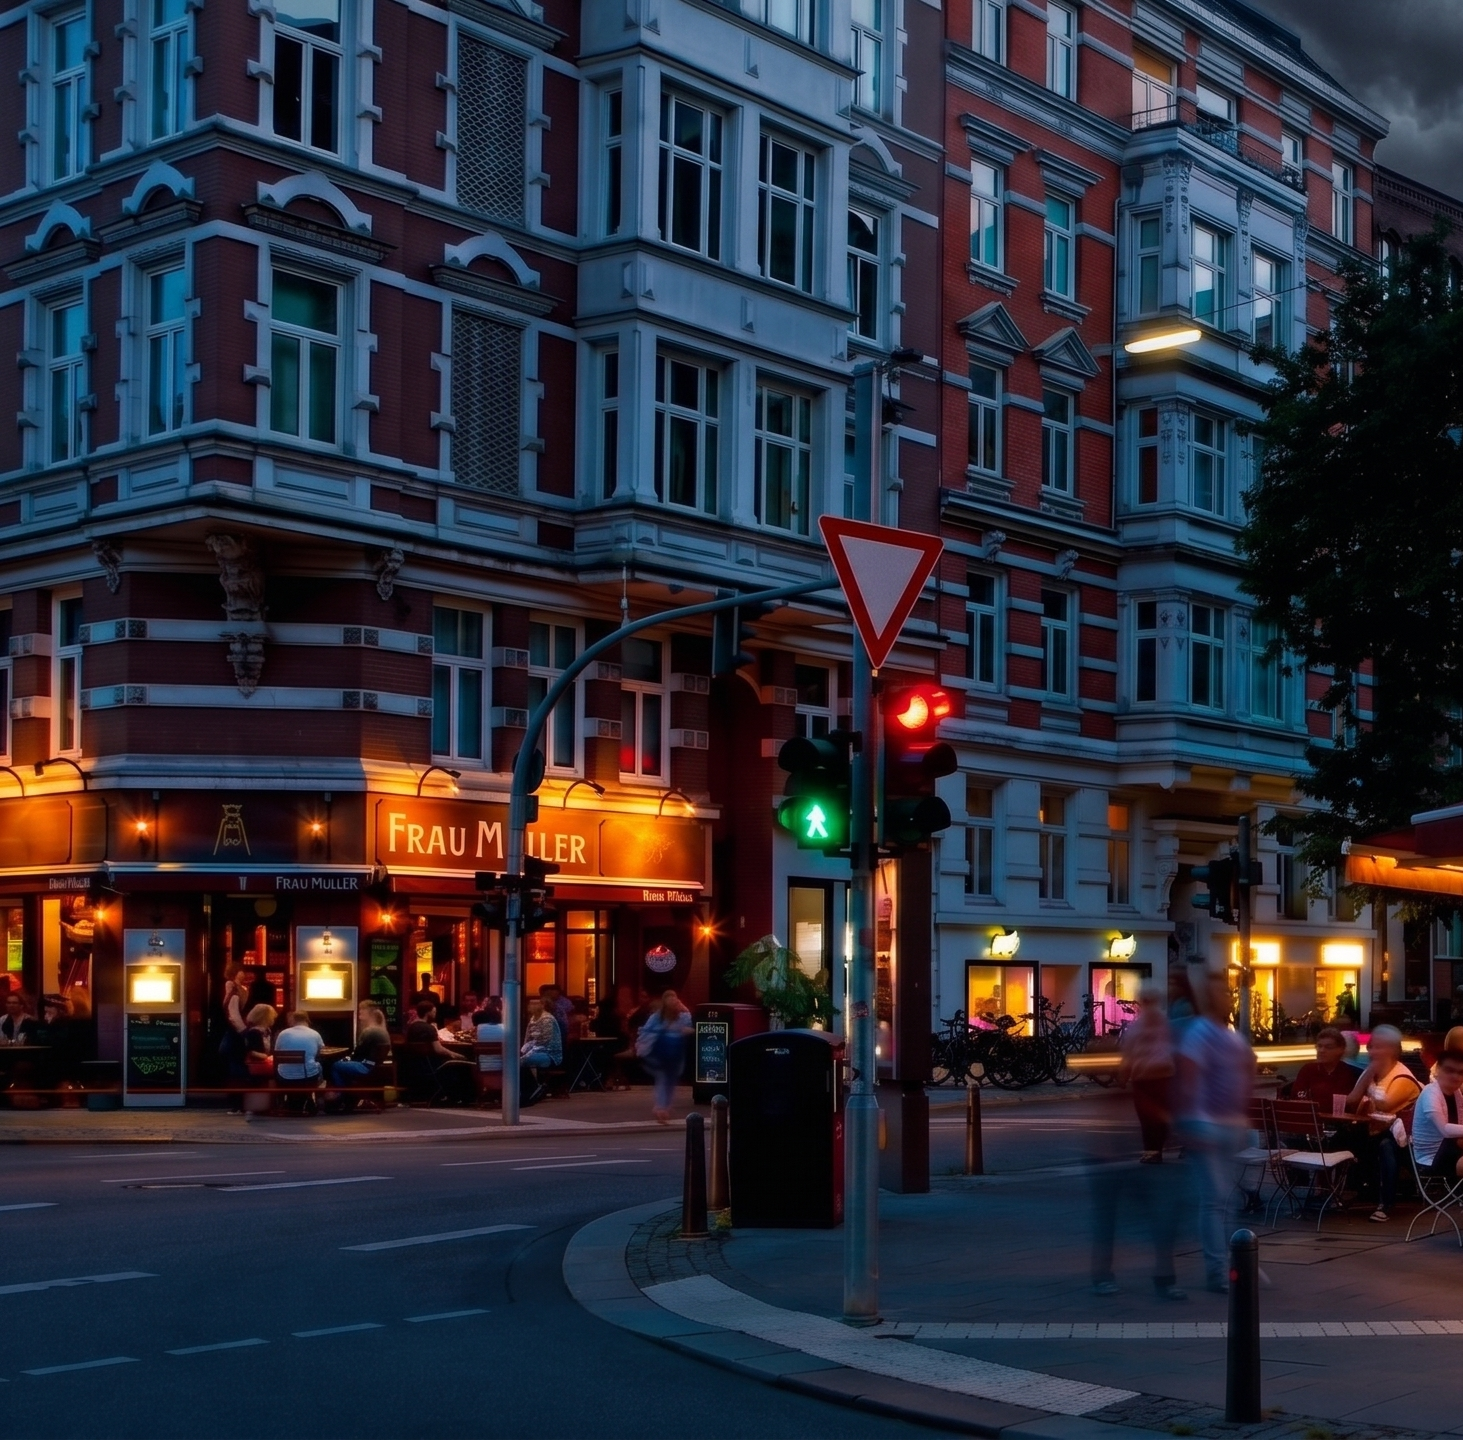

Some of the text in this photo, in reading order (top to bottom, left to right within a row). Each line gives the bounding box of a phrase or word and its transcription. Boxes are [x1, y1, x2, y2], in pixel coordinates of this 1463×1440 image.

[389, 812, 587, 864] FRAU MLLER
[276, 876, 359, 890] FRAU MULLER
